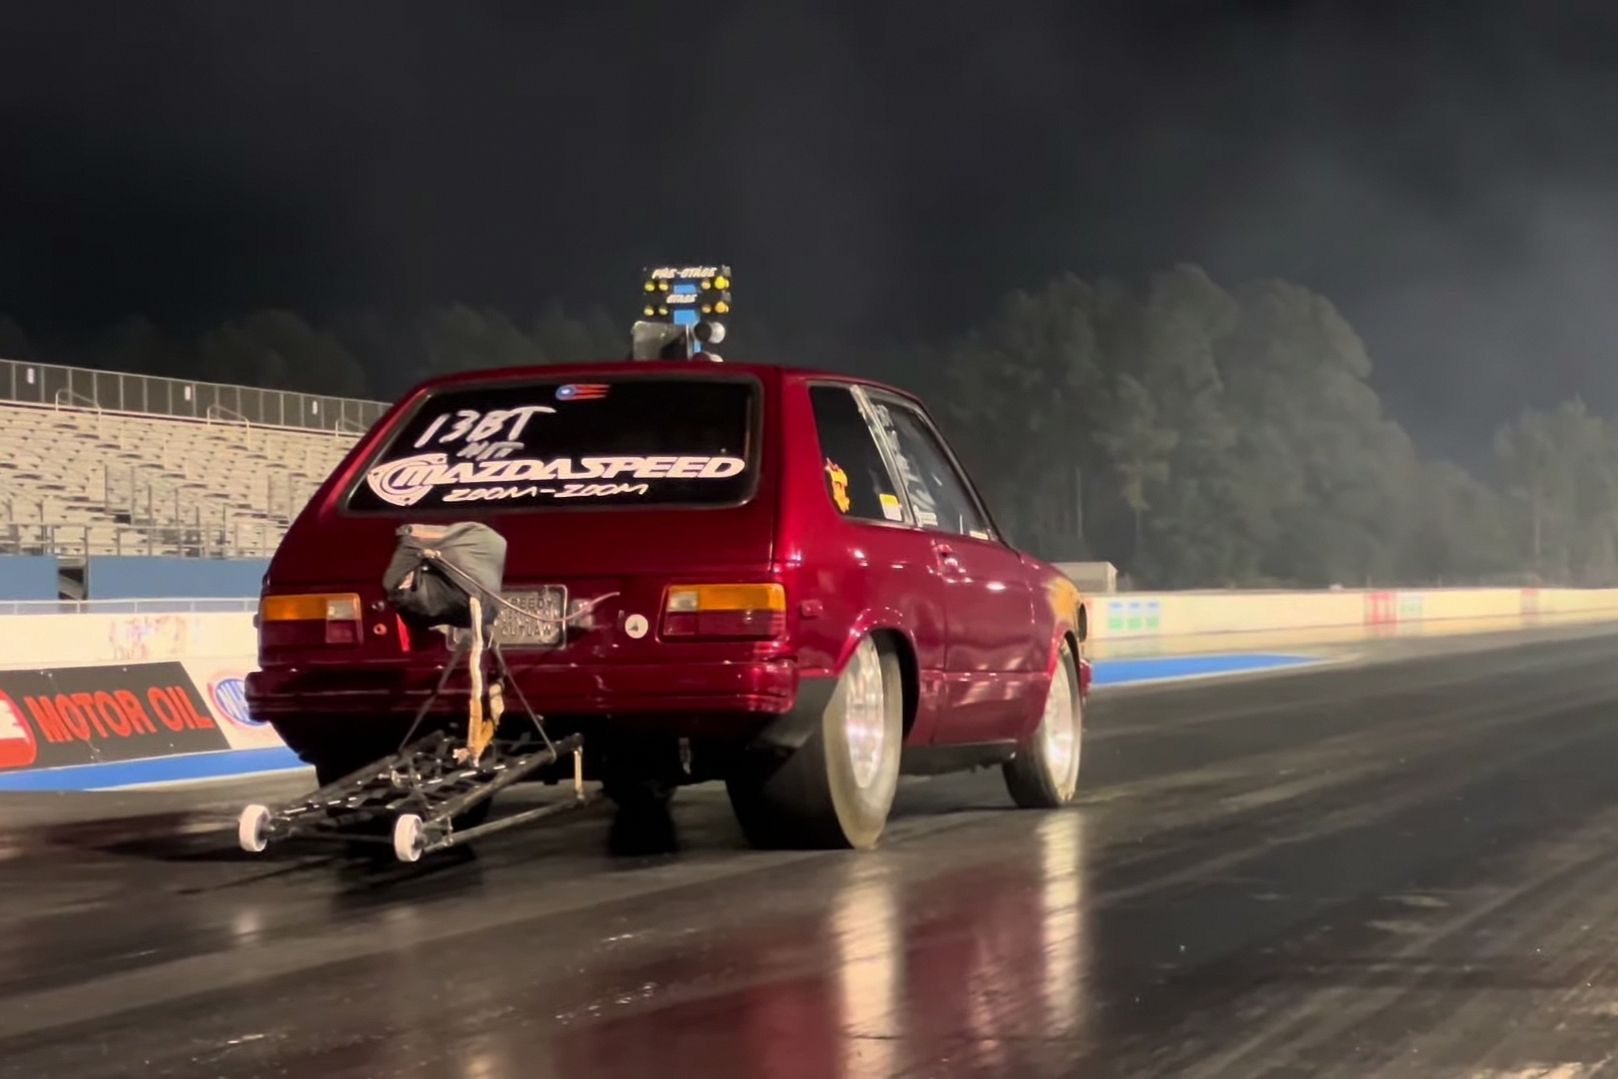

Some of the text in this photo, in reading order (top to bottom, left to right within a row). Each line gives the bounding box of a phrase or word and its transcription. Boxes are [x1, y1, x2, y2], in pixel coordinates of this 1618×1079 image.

[414, 406, 557, 448] 13BT
[385, 455, 746, 490] MAZDASPEED
[442, 482, 649, 502] ZOOM-ZOOM
[23, 689, 157, 743] MOTOR
[147, 685, 216, 732] OIL
